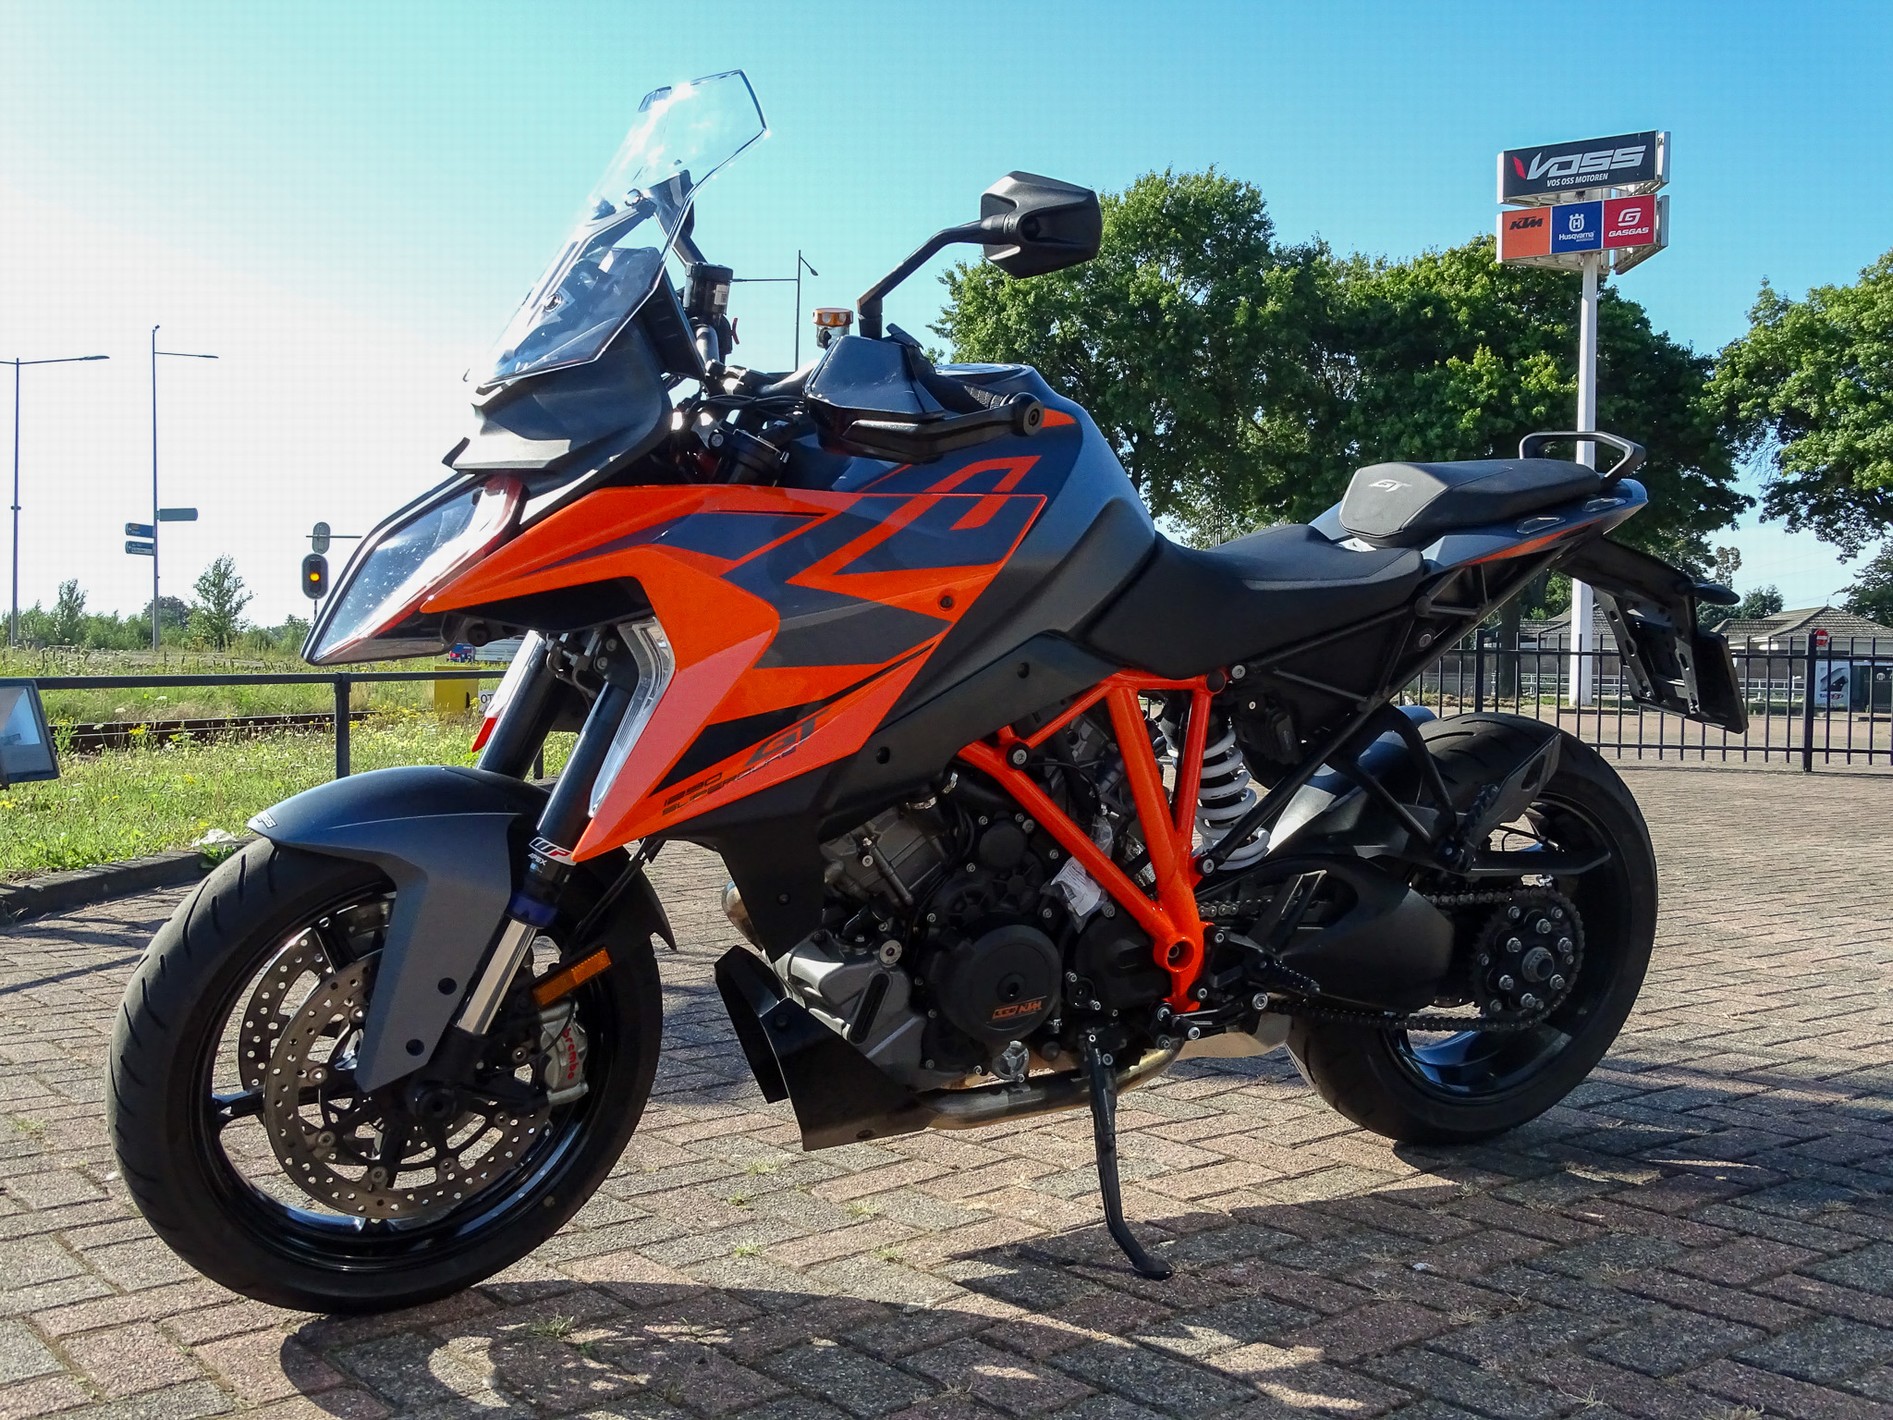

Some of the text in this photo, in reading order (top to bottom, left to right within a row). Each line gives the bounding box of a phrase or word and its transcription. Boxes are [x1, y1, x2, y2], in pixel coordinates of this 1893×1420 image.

[1513, 145, 1647, 180] VOSS
[1546, 173, 1608, 187] VOS OSS MOTOREN
[1509, 216, 1543, 231] KTM
[1558, 231, 1595, 242] Husqvarna
[1608, 227, 1649, 238] GASGAS
[561, 1027, 579, 1080] brembo
